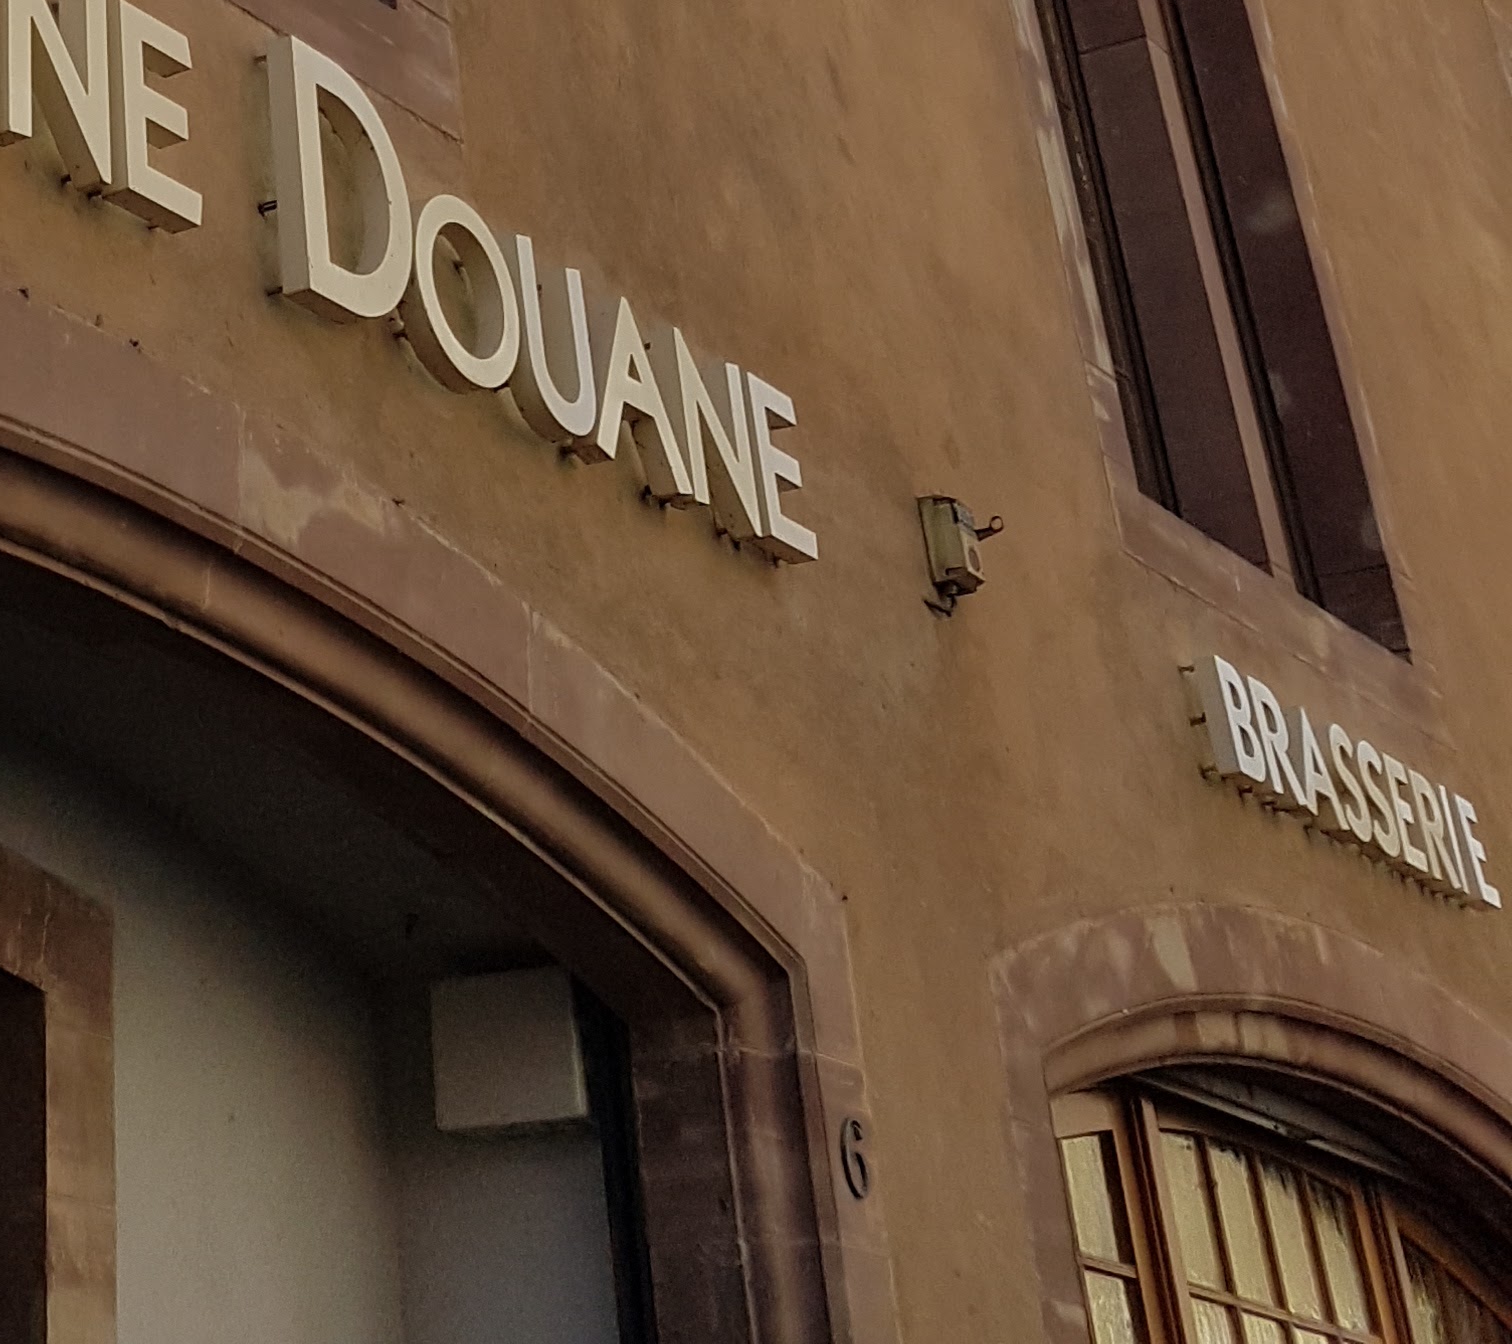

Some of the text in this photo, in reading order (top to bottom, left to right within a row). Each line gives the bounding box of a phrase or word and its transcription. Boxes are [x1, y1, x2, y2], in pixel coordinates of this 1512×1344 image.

[289, 35, 819, 560] DOUANE
[1212, 655, 1502, 909] BRASSERIE
[841, 1118, 868, 1200] 6
